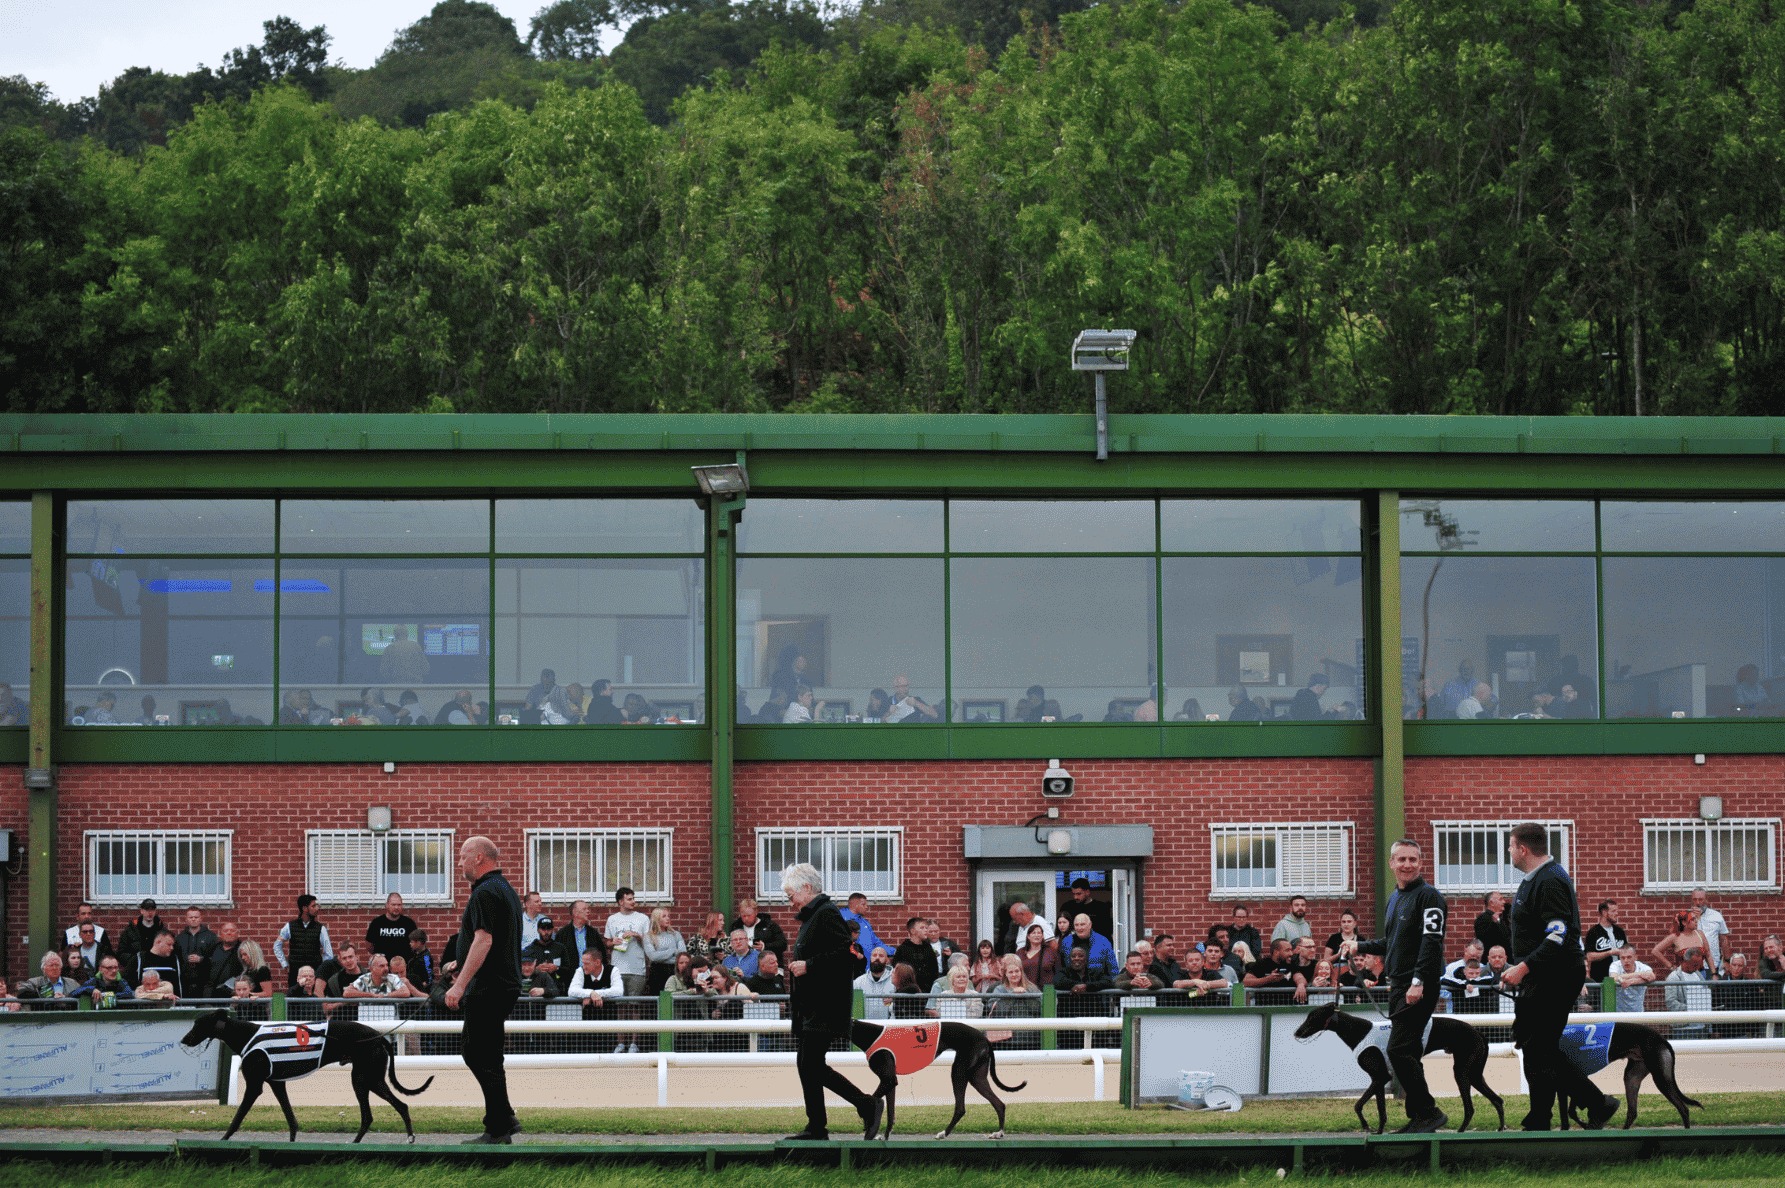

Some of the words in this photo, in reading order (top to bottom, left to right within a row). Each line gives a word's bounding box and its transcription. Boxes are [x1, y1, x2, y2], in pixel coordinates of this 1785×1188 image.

[1425, 909, 1443, 933] 3
[379, 927, 406, 935] HUGO
[1545, 920, 1566, 945] 2
[296, 1024, 310, 1046] 6
[914, 1025, 928, 1043] 5
[1584, 1024, 1597, 1045] 2
[140, 1042, 174, 1059] ALUPANEL
[137, 1073, 172, 1090] ALUPANEL
